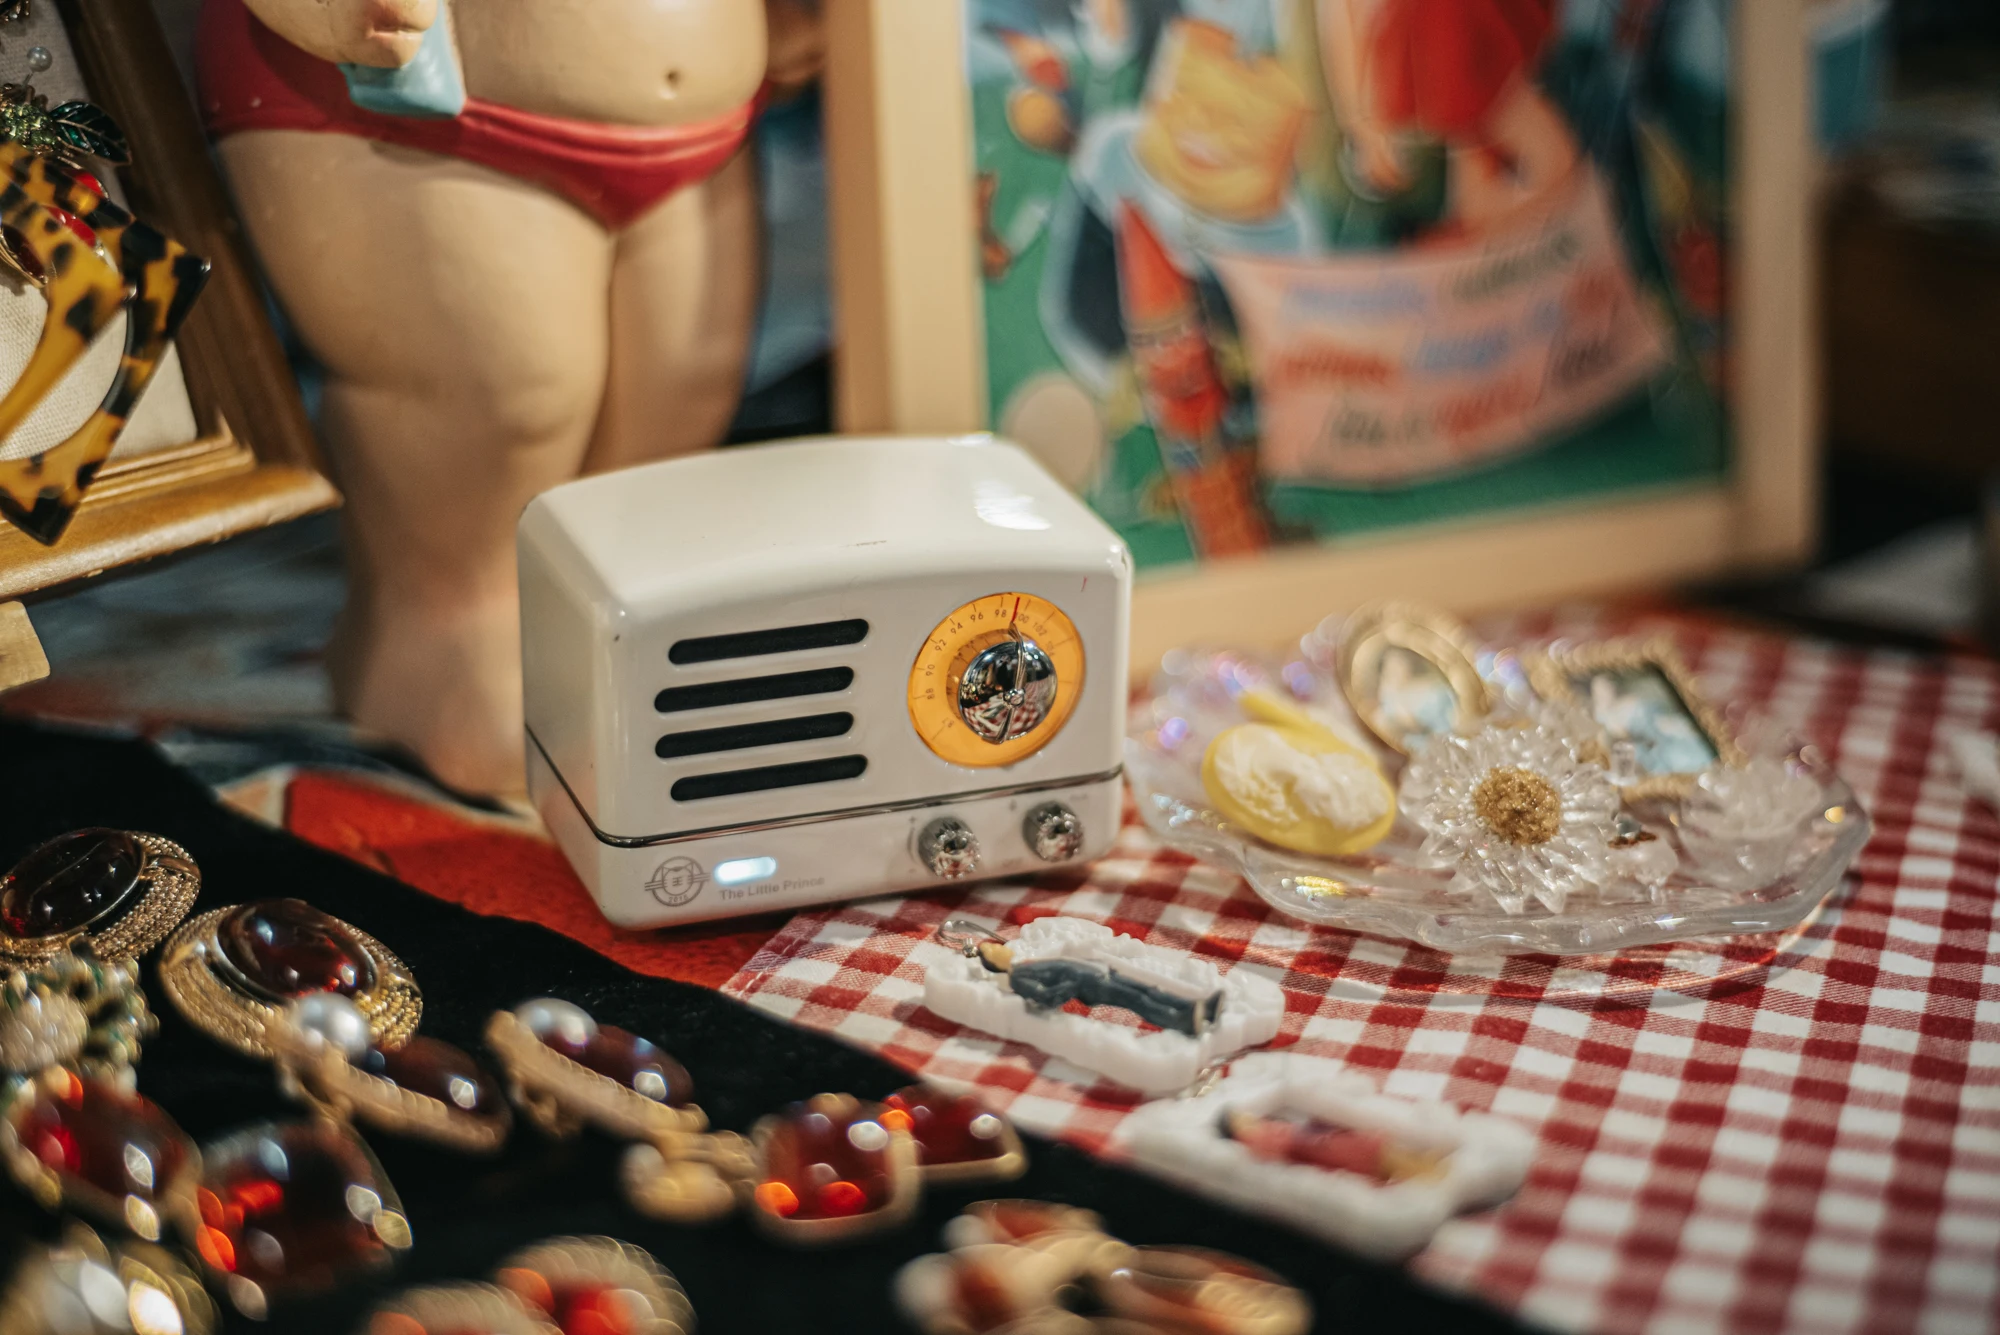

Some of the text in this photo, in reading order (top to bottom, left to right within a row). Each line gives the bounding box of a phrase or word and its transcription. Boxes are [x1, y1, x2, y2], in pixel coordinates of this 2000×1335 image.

[970, 612, 984, 622] 96
[994, 609, 1007, 618] 98
[950, 622, 963, 635] 94
[934, 638, 947, 651] 92
[925, 664, 935, 677] 90
[926, 688, 935, 700] 88
[719, 876, 826, 901] The Little Prince
